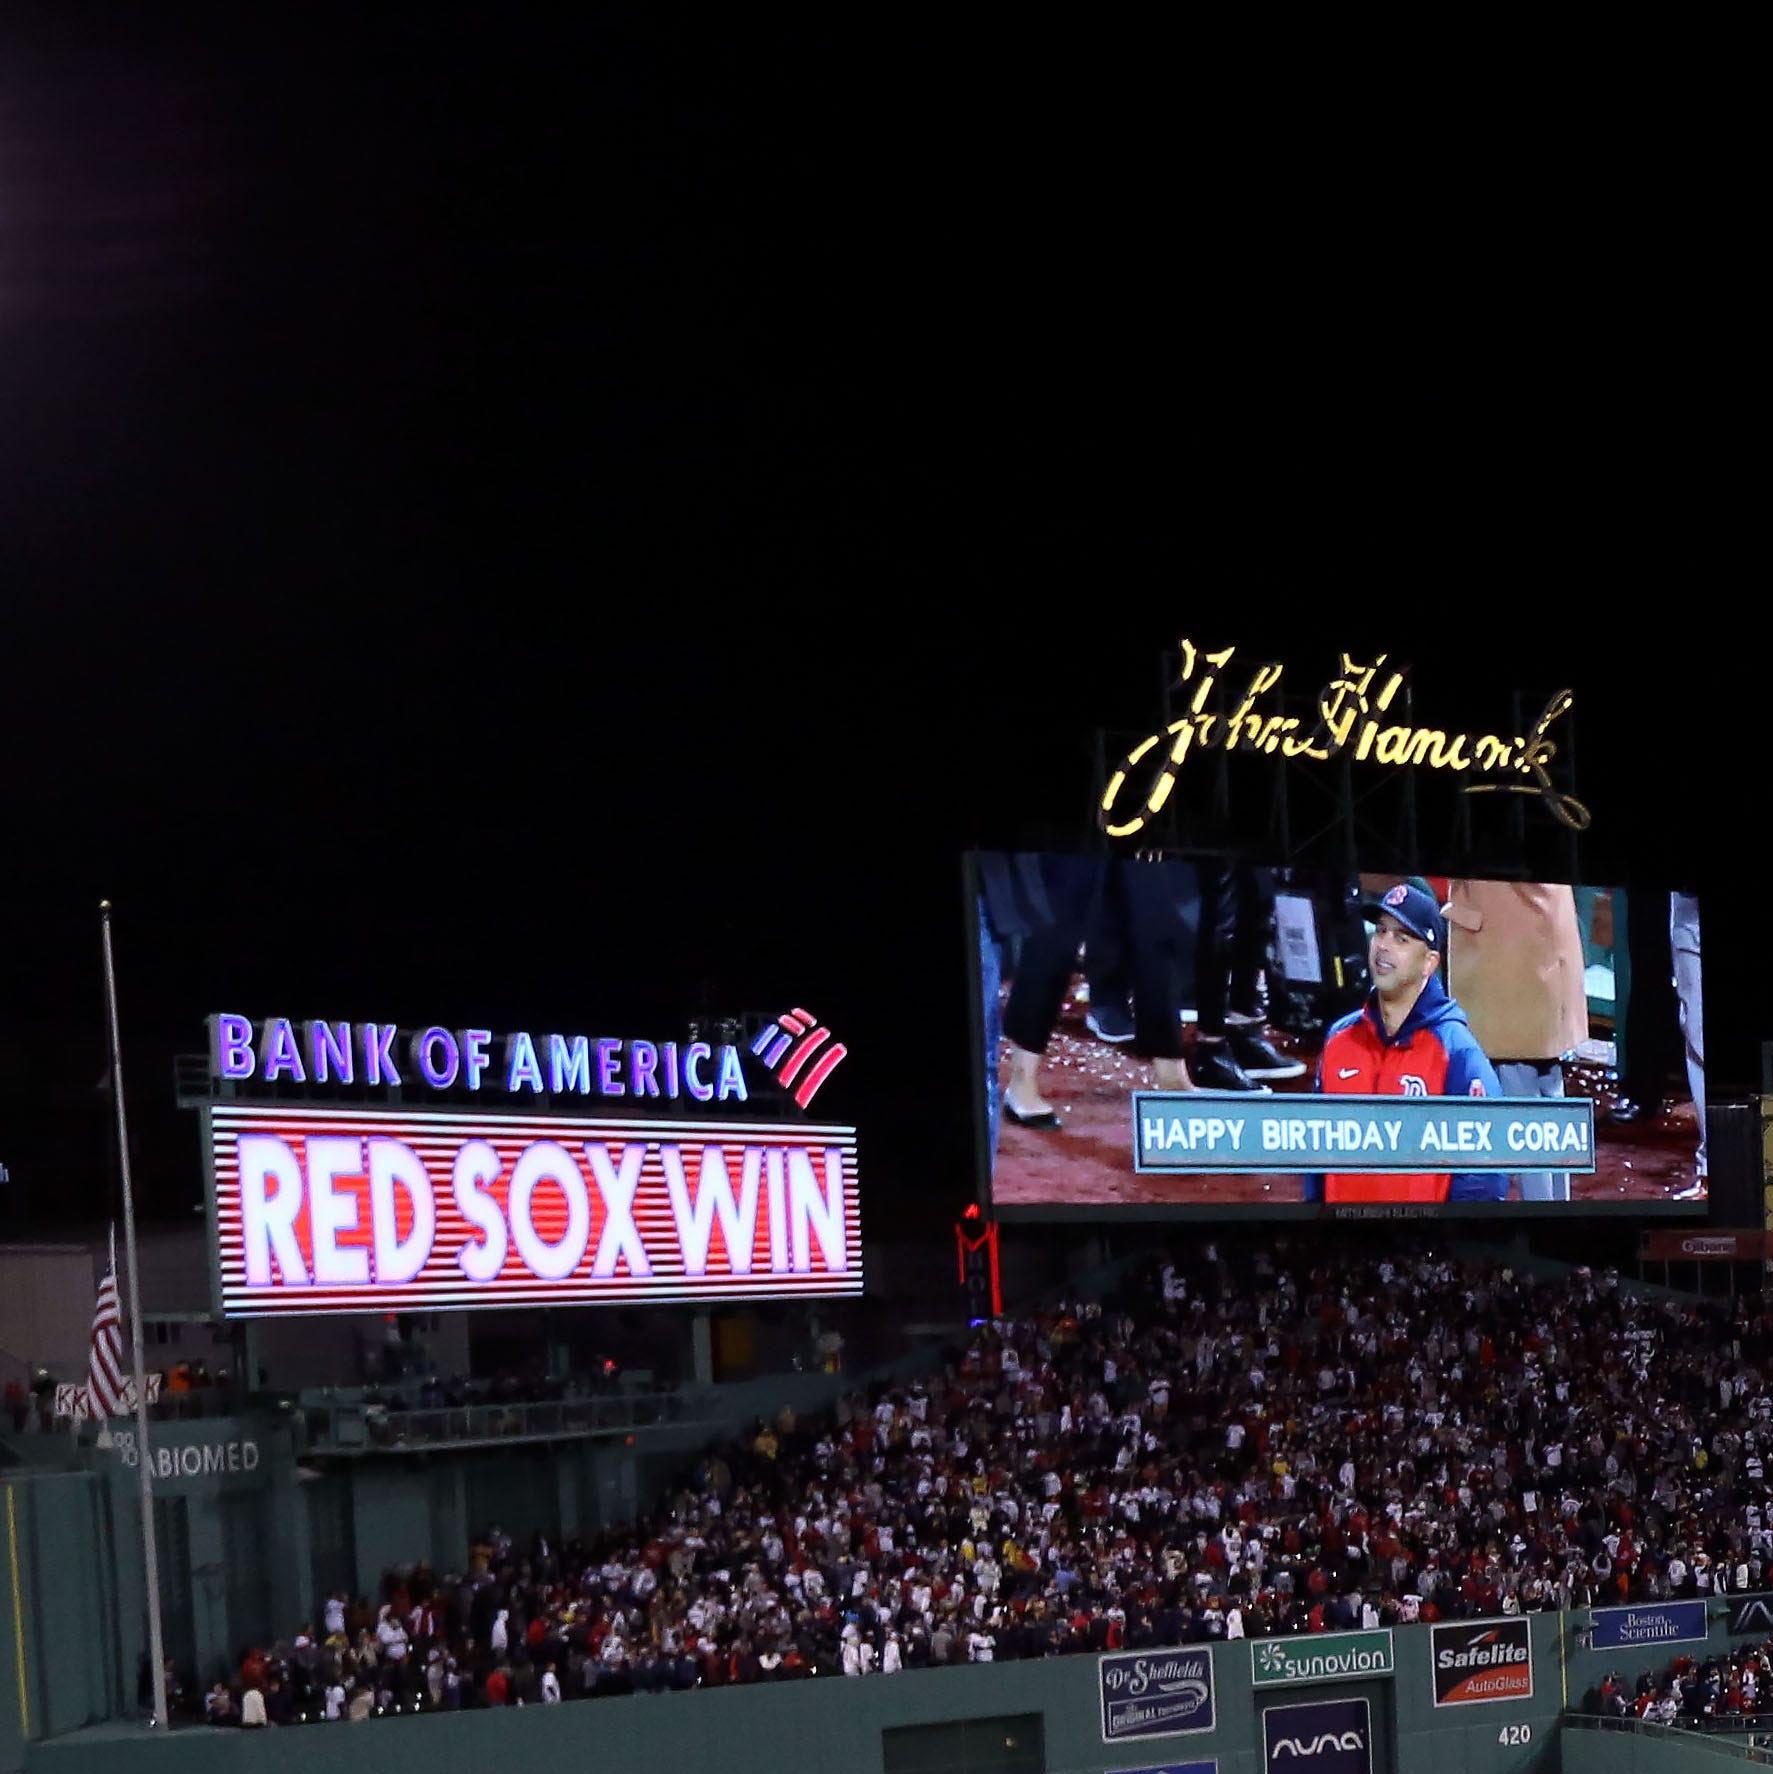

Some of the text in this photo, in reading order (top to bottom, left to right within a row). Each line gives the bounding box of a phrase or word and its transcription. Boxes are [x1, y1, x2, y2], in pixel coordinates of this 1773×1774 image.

[1102, 639, 1312, 836] John
[219, 1014, 747, 1100] BANK OF AMERICA
[1142, 1118, 1588, 1151] HAPPY BIRTHDAY ALEX CORA!
[239, 1134, 846, 1285] RED SOX WIN
[1619, 1621, 1680, 1640] Scientific
[1627, 1613, 1666, 1627] Boston
[1285, 1648, 1385, 1678] sunovion
[1438, 1643, 1528, 1670] Safelite
[1465, 1676, 1529, 1694] AutoGlass
[1272, 1732, 1363, 1760] nuna
[1499, 1724, 1531, 1747] 420
